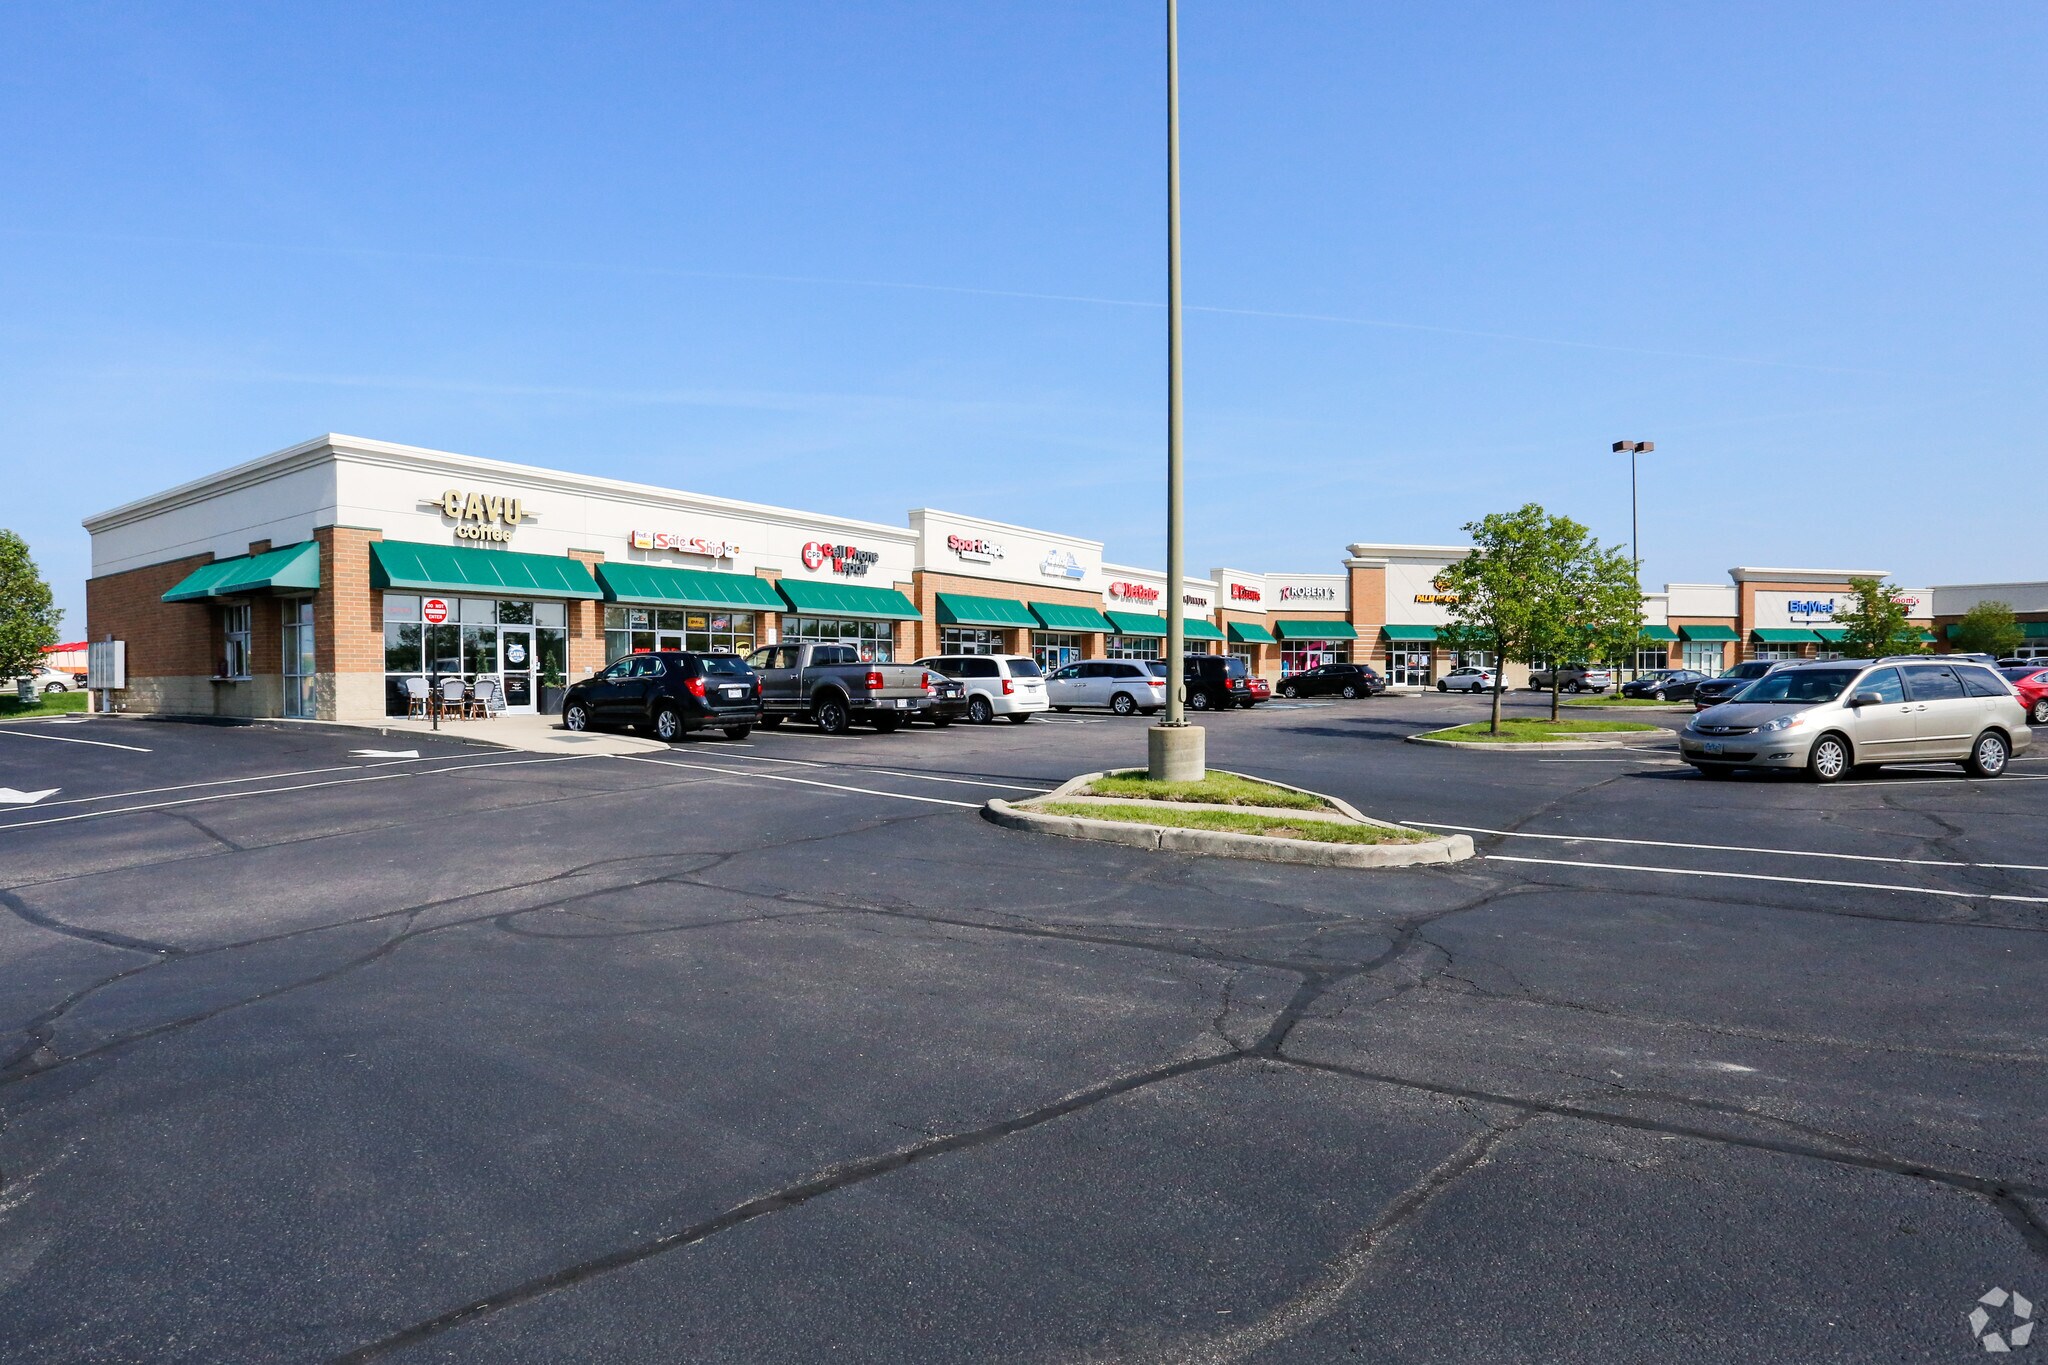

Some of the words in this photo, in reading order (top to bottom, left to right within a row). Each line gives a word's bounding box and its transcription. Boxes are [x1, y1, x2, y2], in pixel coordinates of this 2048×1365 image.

[442, 489, 522, 525] CAVU
[455, 524, 513, 542] coffee
[656, 533, 686, 548] Safe
[694, 539, 723, 557] Ship
[822, 543, 846, 559] Cell
[846, 546, 879, 562] Phone
[833, 558, 869, 576] Repair
[1290, 586, 1336, 598] ROBERT'S
[1415, 594, 1435, 603] PALM
